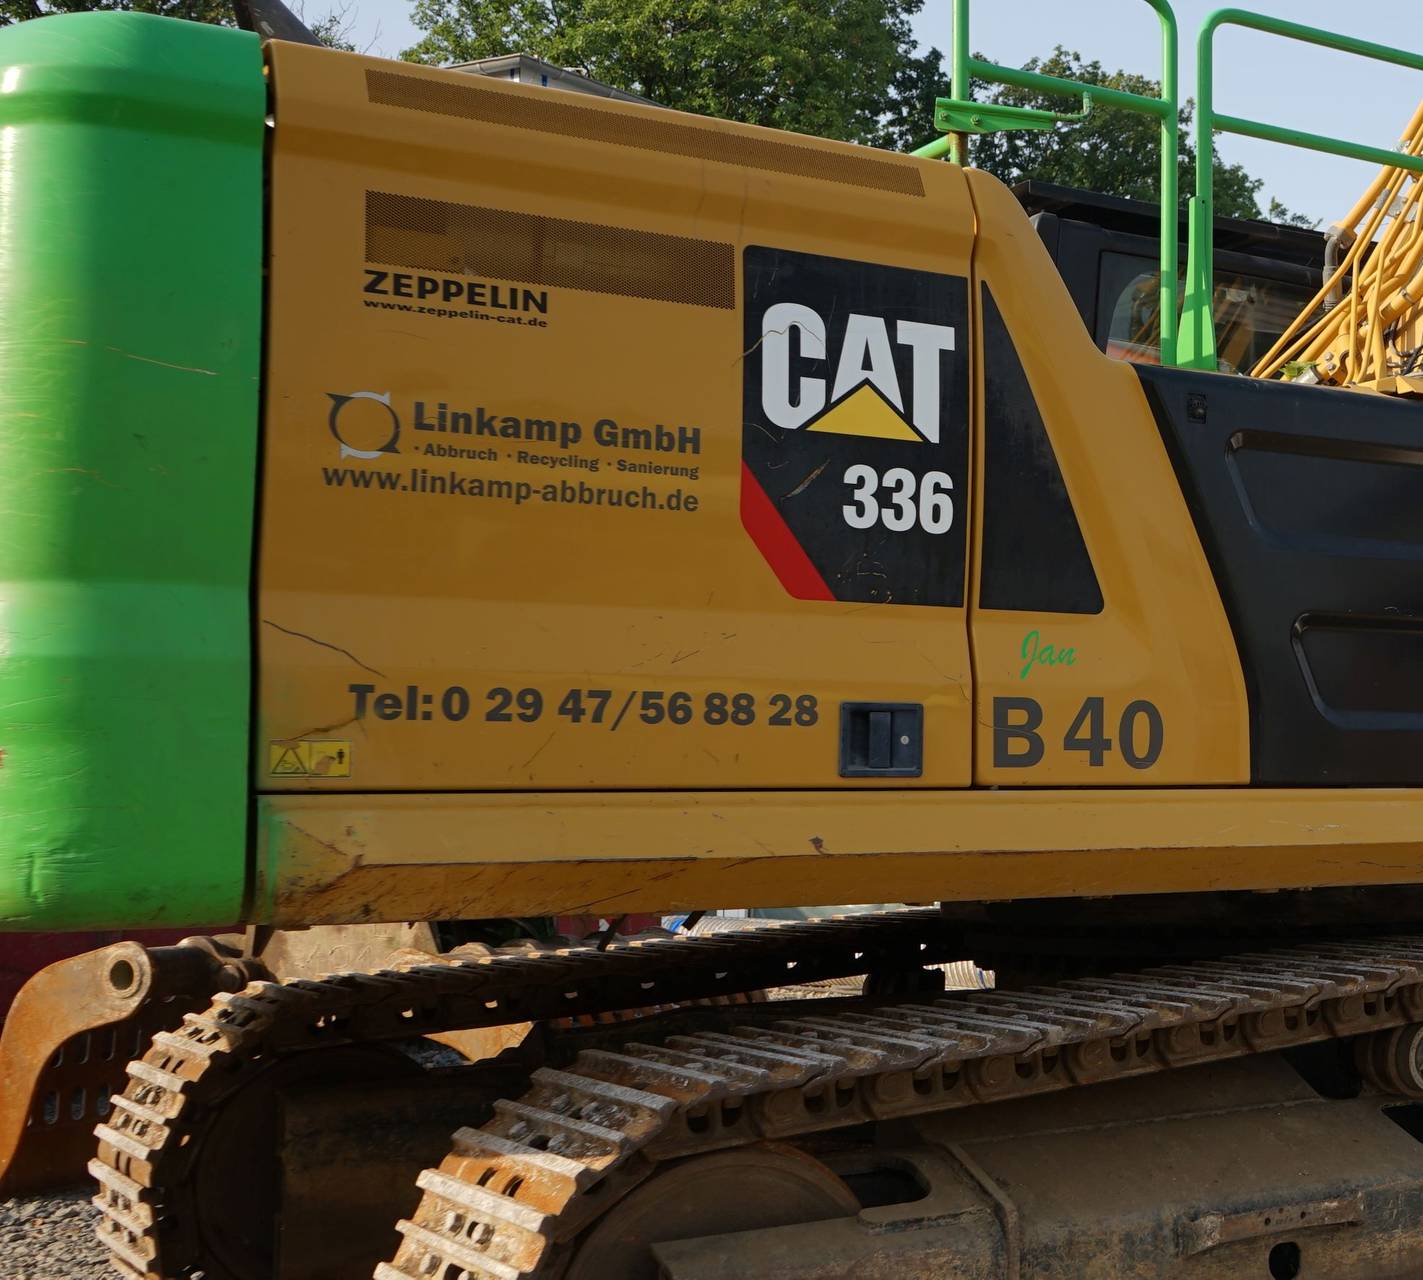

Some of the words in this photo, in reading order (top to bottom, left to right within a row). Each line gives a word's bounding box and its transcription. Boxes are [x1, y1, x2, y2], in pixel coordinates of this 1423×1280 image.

[363, 269, 548, 314] ZEPPELIN
[363, 300, 548, 328] www.zeppelin-cat.de
[762, 302, 956, 444] CAT
[414, 401, 582, 449] Linkamp
[593, 418, 701, 455] GmbH
[423, 443, 498, 461] Abbruch
[517, 450, 600, 473] Recycling
[616, 459, 700, 481] Sanierung
[322, 467, 699, 512] www.linkamp-abbruch.de
[842, 464, 954, 535] 336
[1020, 630, 1078, 680] Jan
[485, 687, 544, 723] 29
[704, 692, 756, 726] 88
[768, 693, 819, 727] 28
